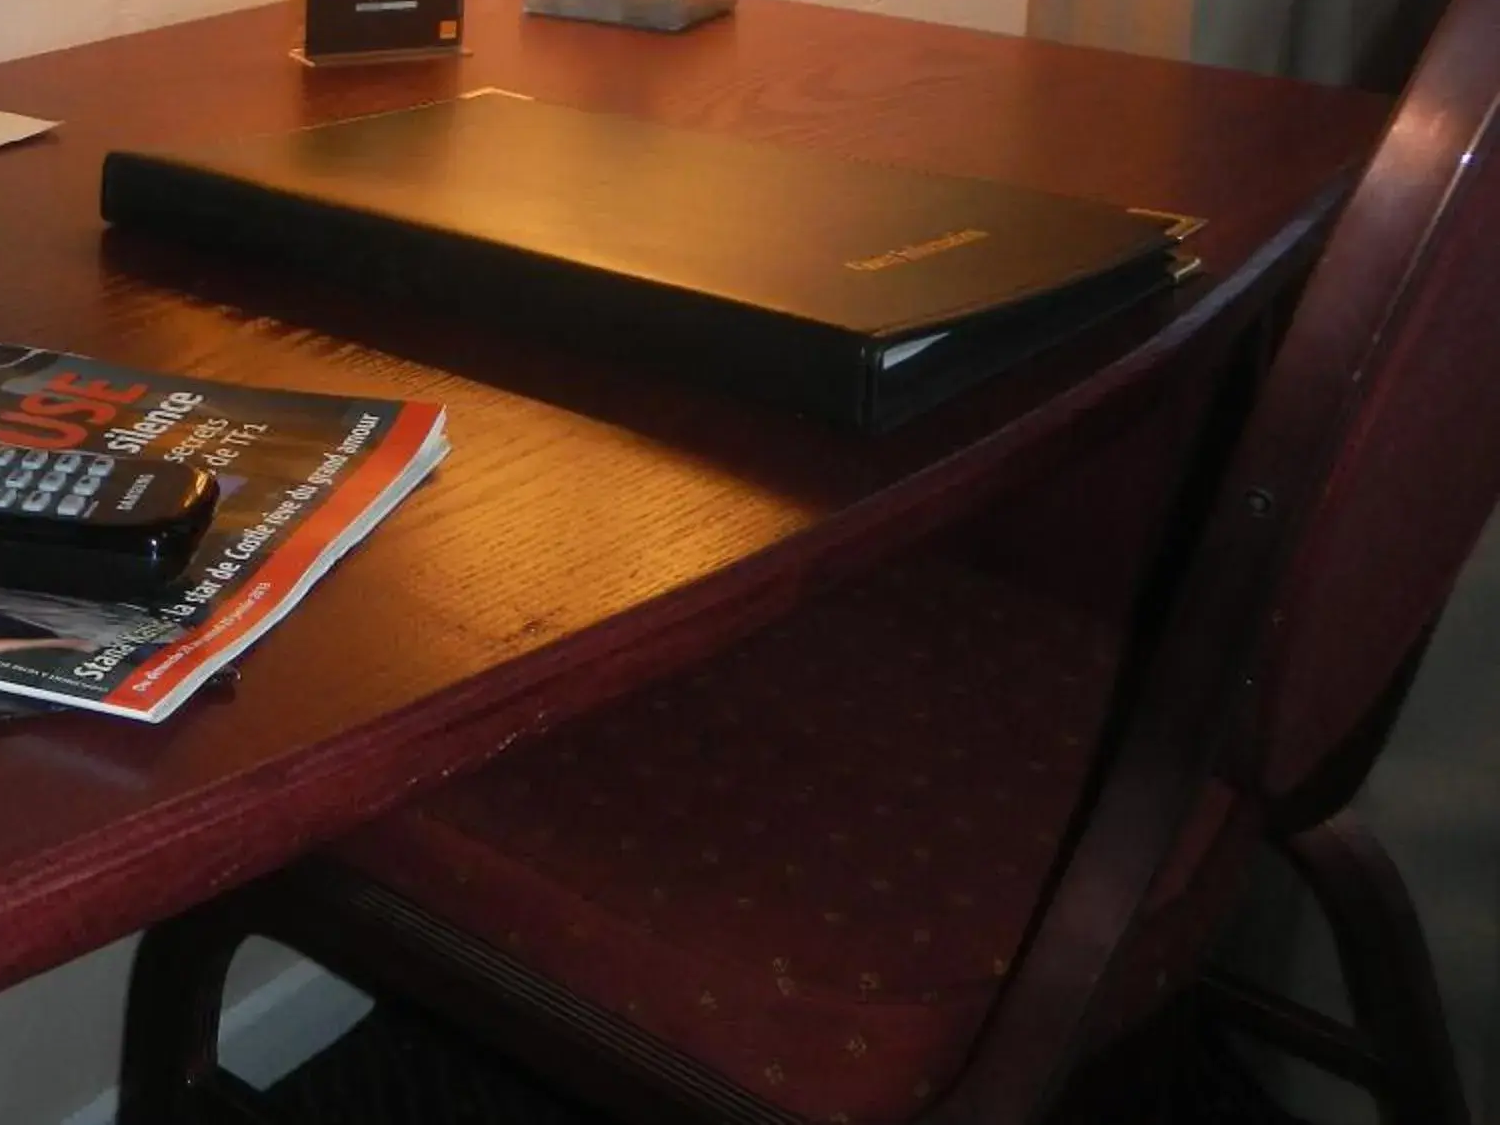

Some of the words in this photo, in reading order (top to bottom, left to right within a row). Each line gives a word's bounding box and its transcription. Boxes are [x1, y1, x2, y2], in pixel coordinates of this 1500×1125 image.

[106, 390, 205, 455] silence
[73, 642, 137, 681] Stana
[159, 603, 197, 617] la
[184, 579, 223, 605] star
[204, 561, 242, 581] de
[285, 483, 320, 501] du
[307, 451, 350, 486] grand
[342, 412, 381, 455] amour
